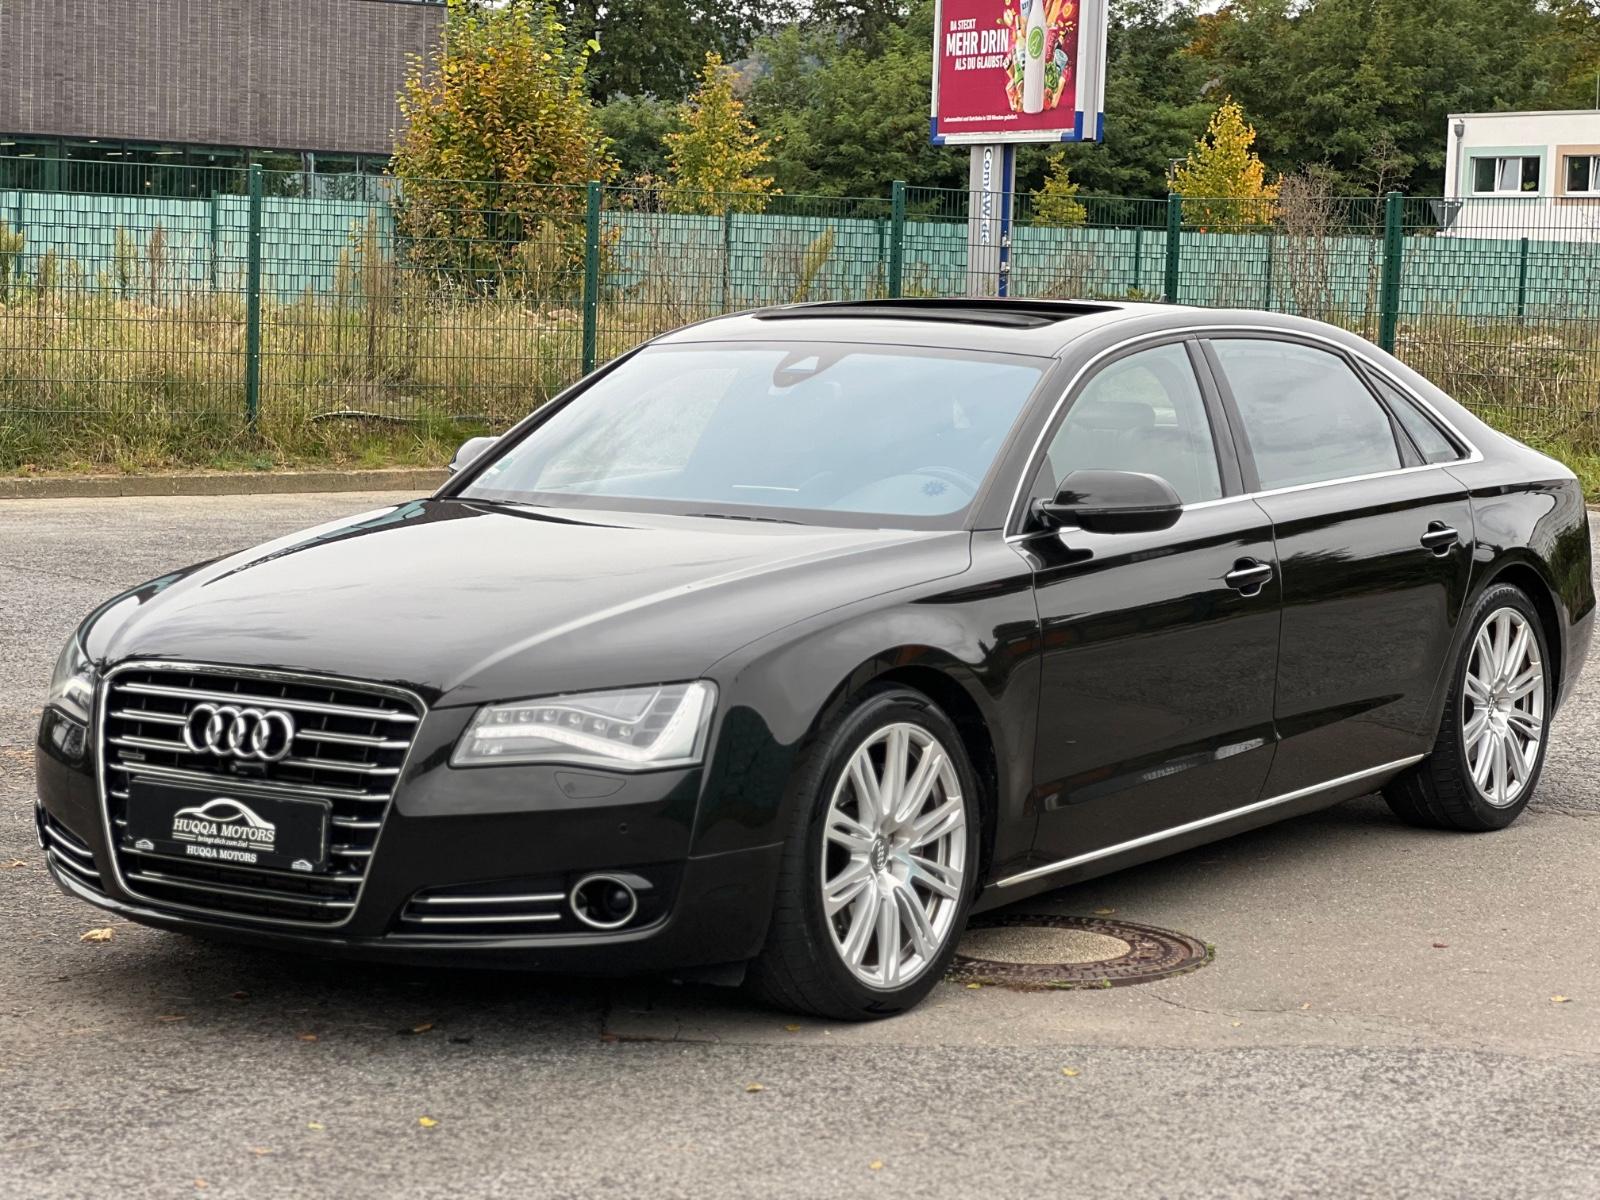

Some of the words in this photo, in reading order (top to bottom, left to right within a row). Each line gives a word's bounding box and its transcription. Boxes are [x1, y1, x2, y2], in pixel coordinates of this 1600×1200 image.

[957, 18, 976, 31] STECKT
[946, 31, 978, 56] MEHR
[980, 28, 1009, 54] DRIN
[954, 57, 967, 71] ALS
[967, 56, 976, 69] DU
[173, 818, 217, 835] HUQQA
[220, 824, 275, 842] MOTORS
[186, 845, 218, 858] HUQQA
[219, 849, 257, 863] MOTORS
